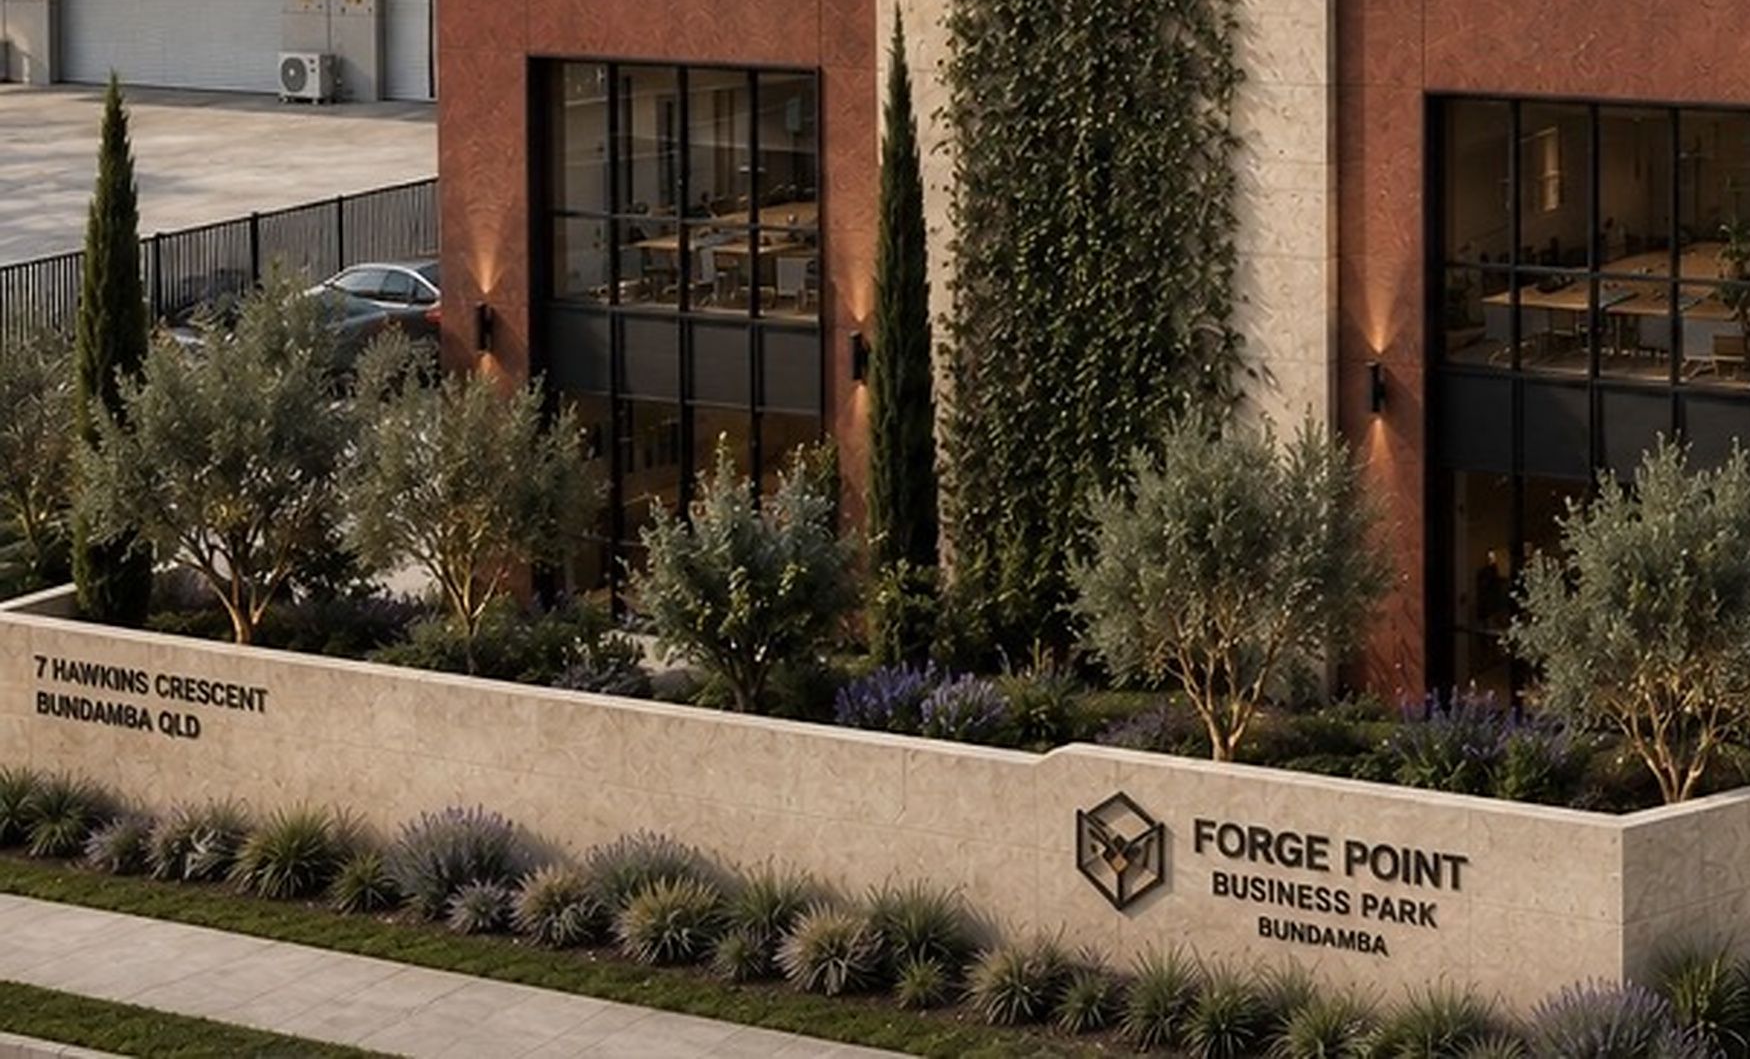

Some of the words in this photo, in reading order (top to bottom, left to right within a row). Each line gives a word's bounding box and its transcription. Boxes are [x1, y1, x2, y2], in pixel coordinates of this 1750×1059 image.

[34, 654, 48, 678] 7
[52, 658, 150, 695] HAWKINS
[155, 673, 269, 713] CRESCENT
[36, 691, 153, 732] BUNDAMBA
[158, 711, 201, 739] QLD
[1194, 818, 1331, 872] FORGE
[1344, 839, 1469, 890] POINT
[1212, 871, 1351, 916] BUSINESS
[1361, 894, 1438, 928] PARK
[1258, 916, 1389, 957] BUNDAMBA
